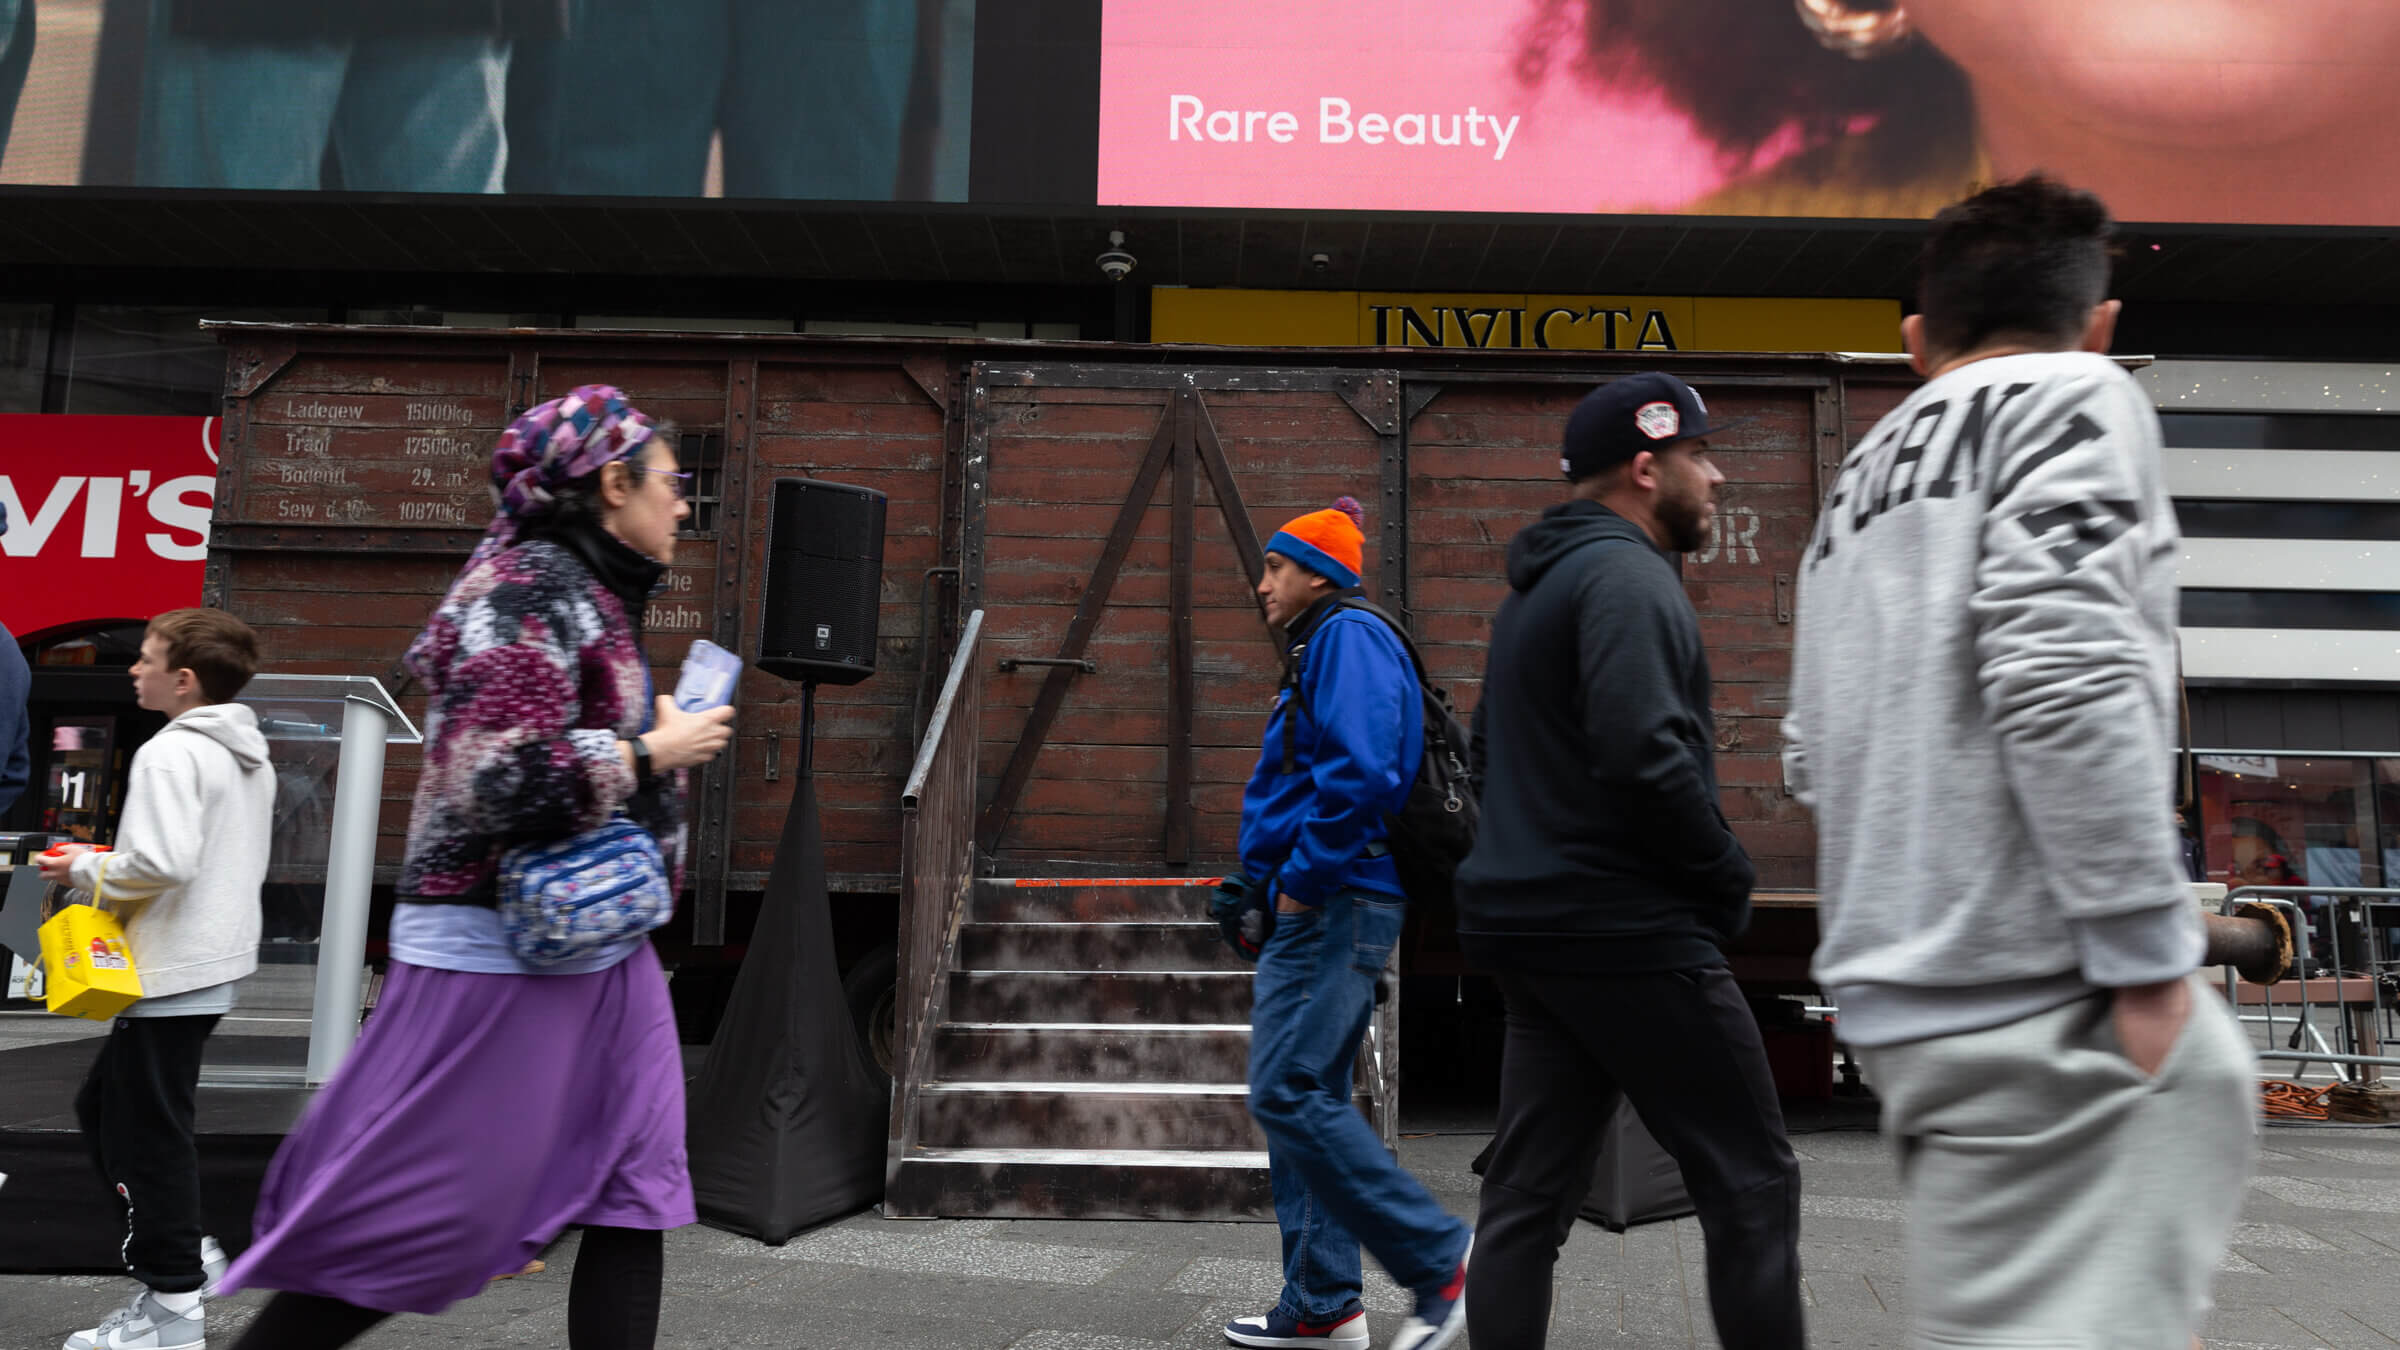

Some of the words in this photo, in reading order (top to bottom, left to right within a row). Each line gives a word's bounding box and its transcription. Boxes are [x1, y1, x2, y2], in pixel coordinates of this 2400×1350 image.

[1169, 94, 1299, 143] Rare
[1319, 97, 1520, 160] Beauty
[1368, 305, 1679, 350] INVICTA
[406, 403, 472, 426] 15000kg
[398, 502, 466, 526] 10870kg
